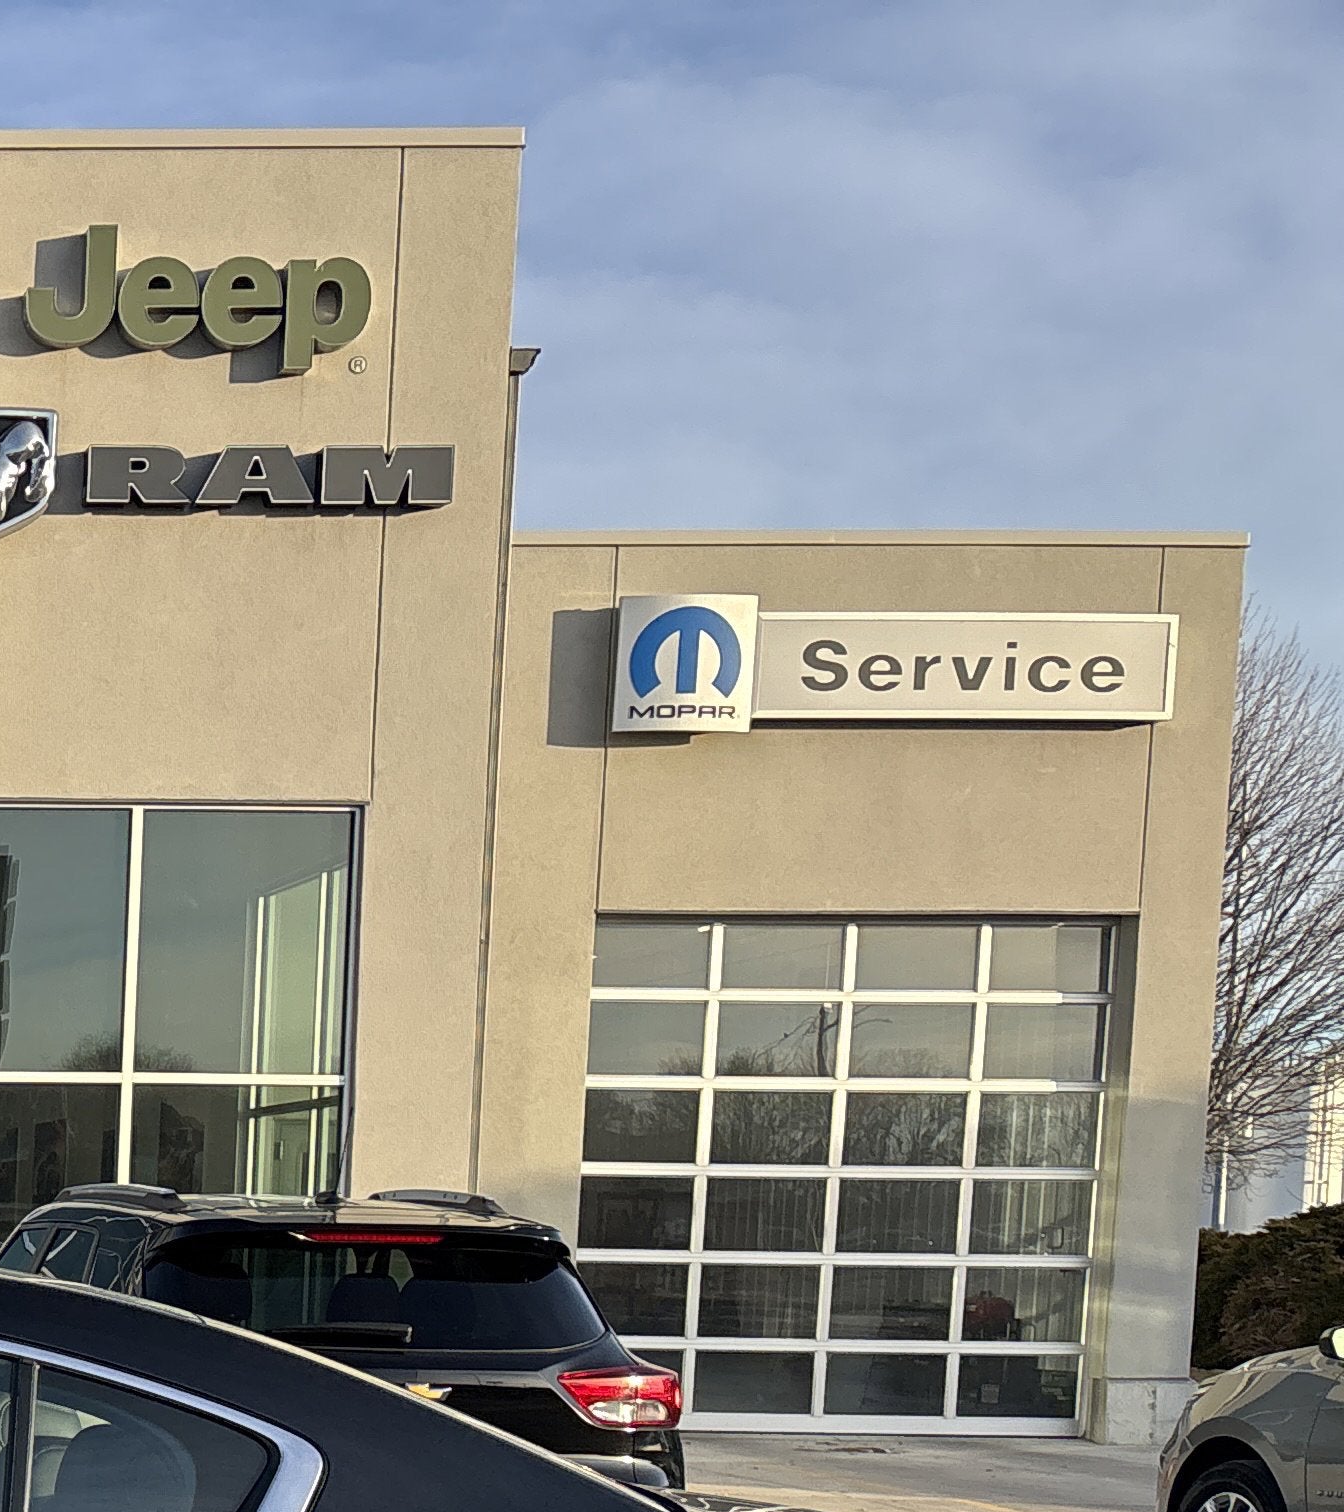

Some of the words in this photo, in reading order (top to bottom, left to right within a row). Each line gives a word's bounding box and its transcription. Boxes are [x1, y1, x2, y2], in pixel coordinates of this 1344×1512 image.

[24, 224, 372, 376] Jeep
[81, 444, 456, 510] RAM
[799, 639, 1127, 695] Service
[627, 704, 736, 720] MOPAR
